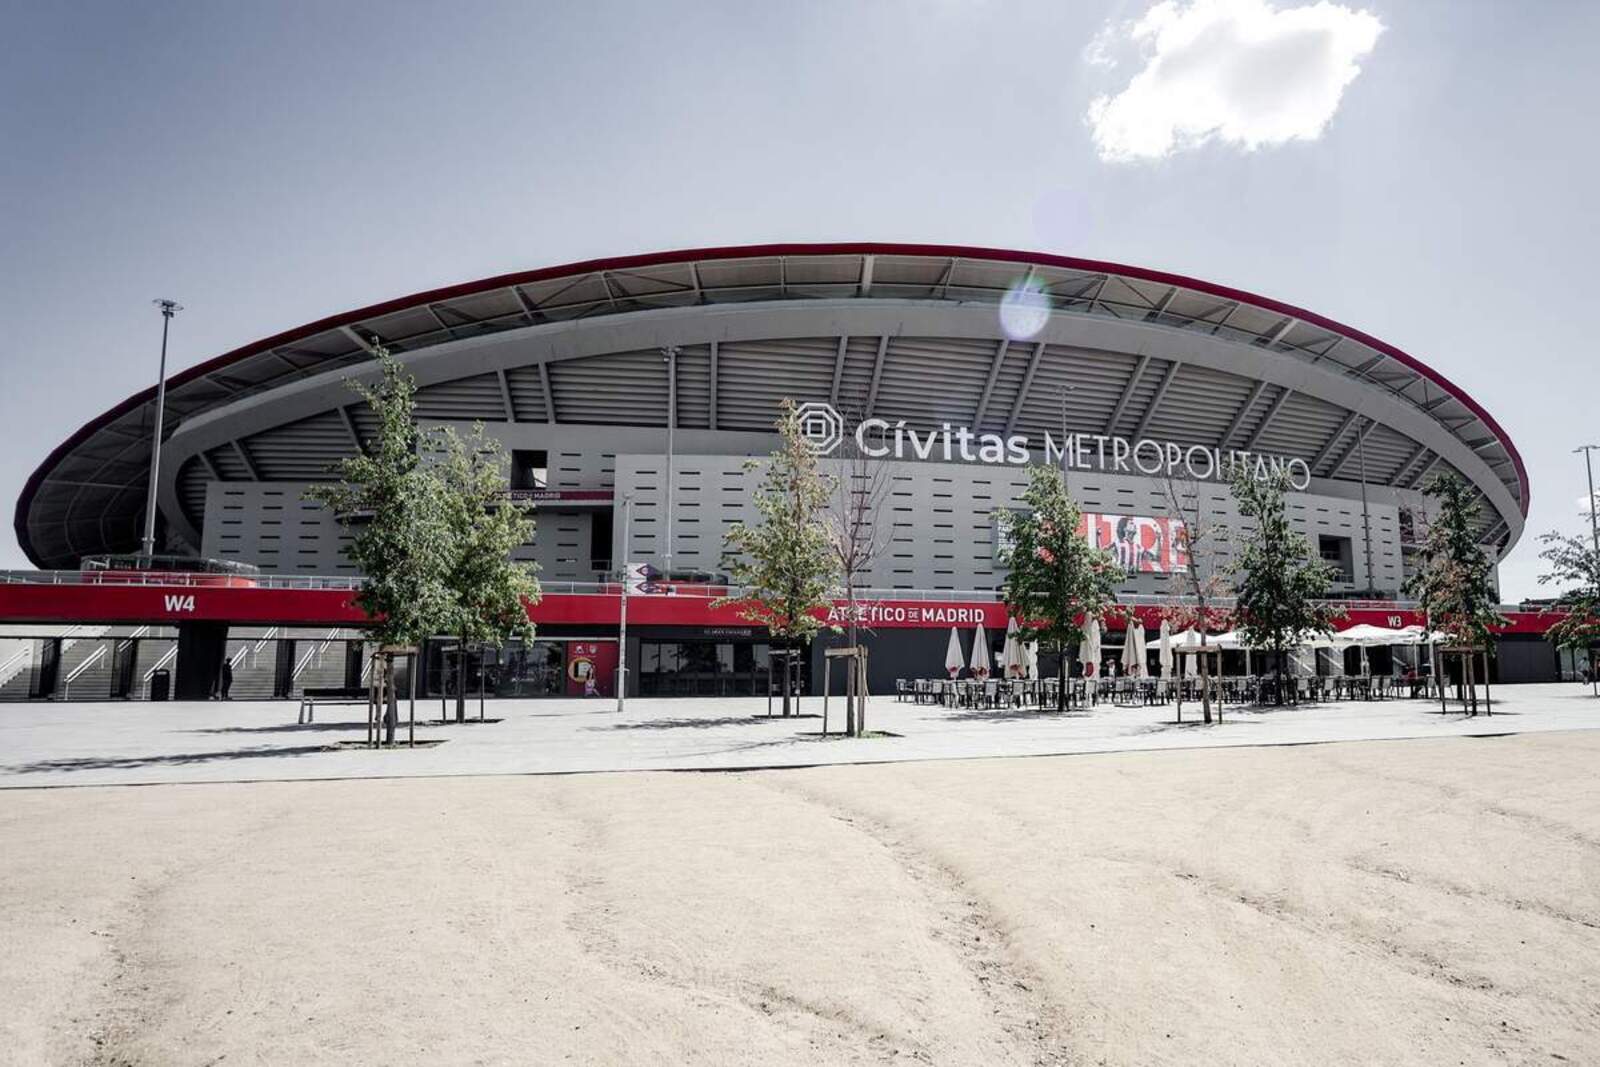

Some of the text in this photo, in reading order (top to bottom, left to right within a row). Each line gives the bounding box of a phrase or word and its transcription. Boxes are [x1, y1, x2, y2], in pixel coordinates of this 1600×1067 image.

[855, 418, 1031, 464] Cívitas
[164, 595, 195, 612] W4
[922, 608, 985, 623] MADRID
[1387, 615, 1402, 628] W3
